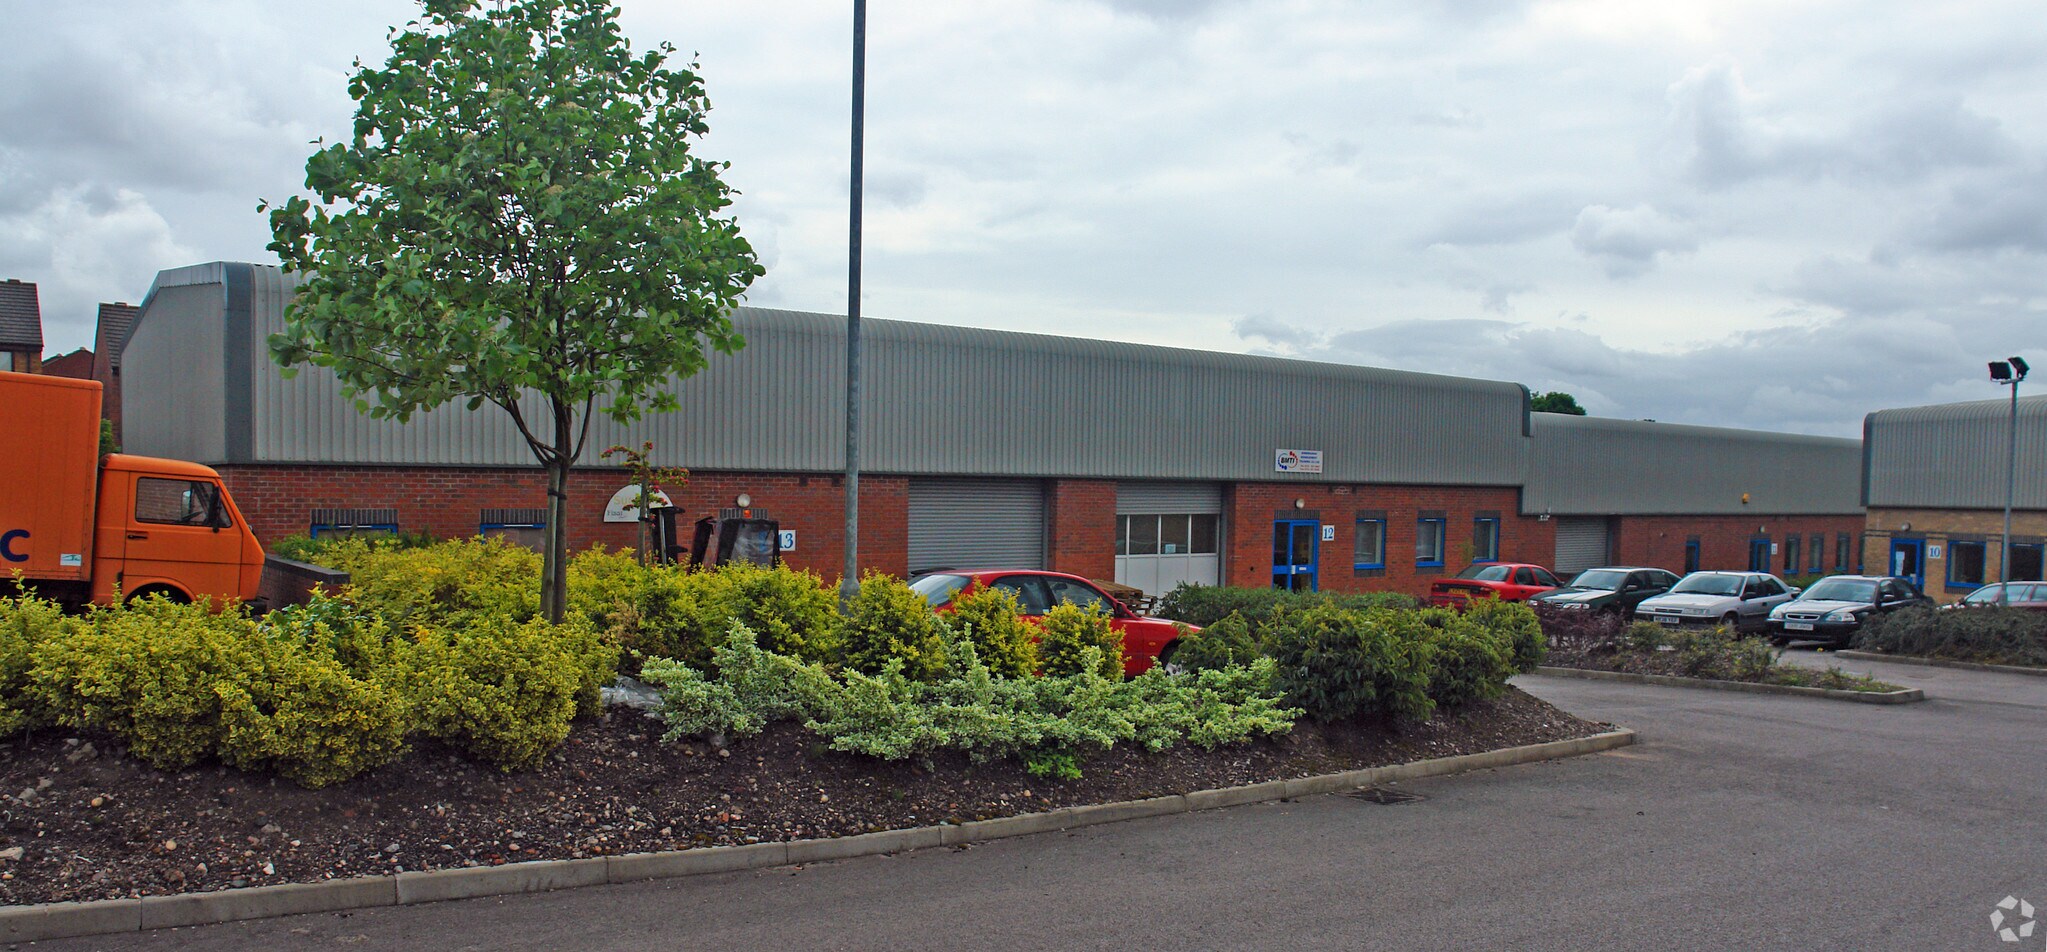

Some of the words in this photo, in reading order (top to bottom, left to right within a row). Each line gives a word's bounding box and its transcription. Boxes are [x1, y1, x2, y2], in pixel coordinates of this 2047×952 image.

[1324, 527, 1334, 539] 12
[0, 529, 31, 563] C
[778, 533, 794, 549] 13
[1929, 546, 1941, 558] 10
